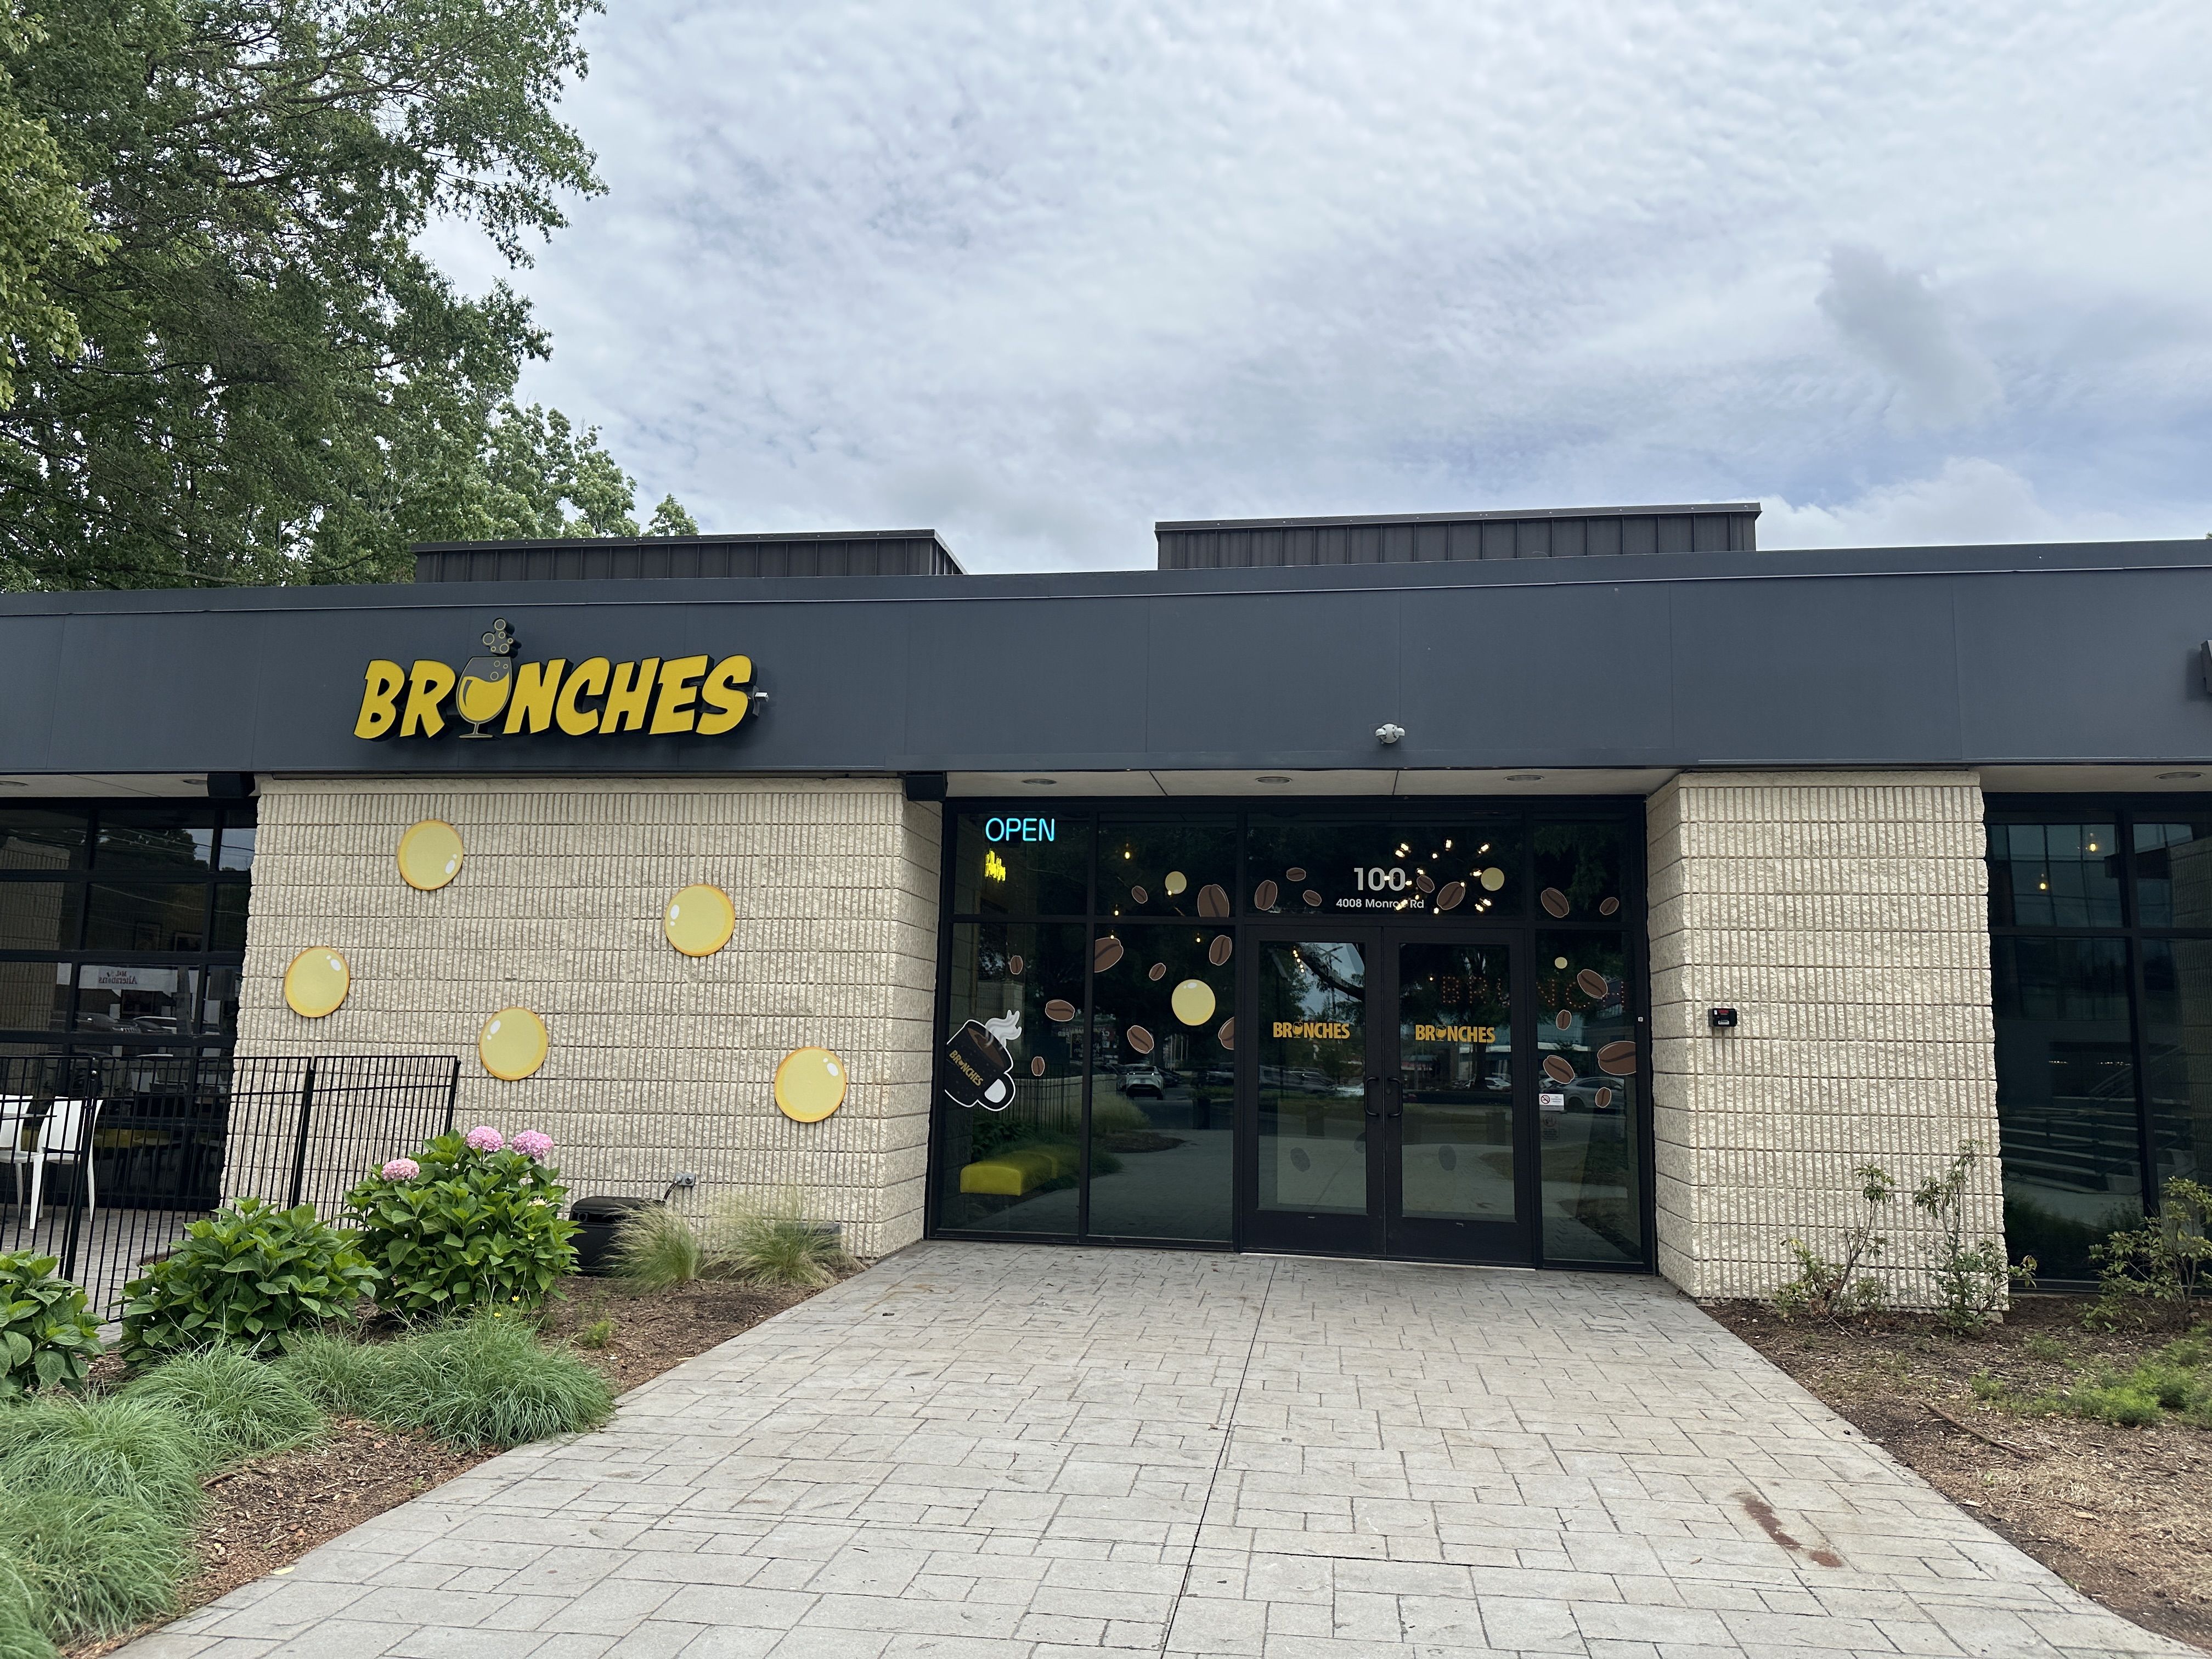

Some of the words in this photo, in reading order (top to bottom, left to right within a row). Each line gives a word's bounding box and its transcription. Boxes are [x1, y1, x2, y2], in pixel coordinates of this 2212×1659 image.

[985, 817, 1055, 842] OPEN
[1353, 867, 1406, 891] 100
[1335, 898, 1362, 908] 4008
[1365, 899, 1407, 909] Monro
[1409, 899, 1425, 909] Rd
